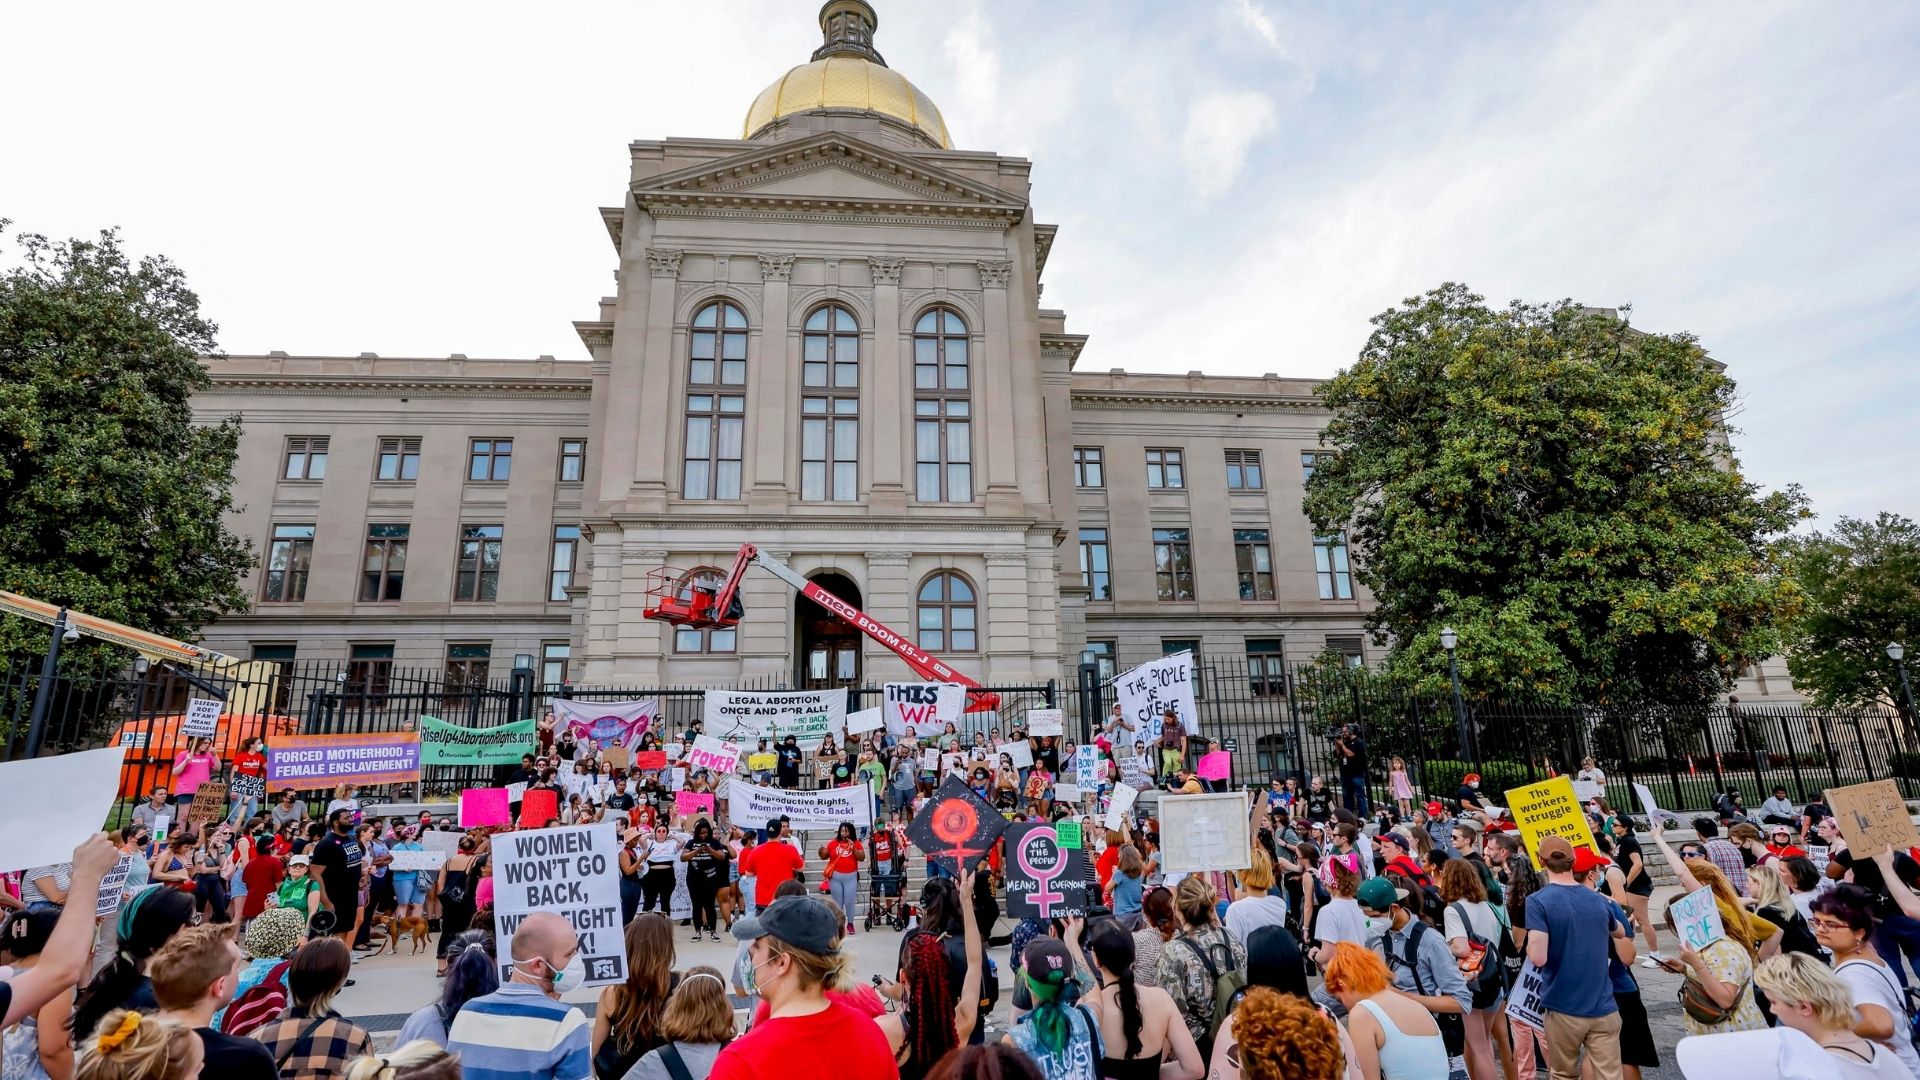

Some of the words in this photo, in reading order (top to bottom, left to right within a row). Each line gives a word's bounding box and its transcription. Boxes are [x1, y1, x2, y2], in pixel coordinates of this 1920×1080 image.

[816, 589, 856, 619] mec
[858, 617, 900, 647] BOOM
[899, 643, 929, 664] 45-J
[1126, 676, 1147, 696] THE
[728, 697, 761, 705] LEGAL
[766, 695, 821, 705] ABORTION
[886, 685, 939, 704] THIS
[720, 707, 751, 715] ONCE
[754, 707, 777, 715] AND
[806, 704, 828, 714] ALL!
[899, 703, 943, 725] WA
[809, 715, 828, 723] BACK
[806, 723, 828, 731] BACK!
[421, 726, 534, 748] RiseUp4AbortionRights.org
[274, 750, 323, 763] FORCED
[326, 747, 403, 761] MOTHERHOOD
[1081, 746, 1092, 757] MY
[690, 748, 736, 774] POWER
[1078, 758, 1095, 769] BODY
[275, 763, 325, 778] FEMALE
[328, 758, 413, 775] ENSLAVEMENT!
[1081, 768, 1092, 778] MY
[231, 778, 265, 791] FORCED
[241, 773, 264, 785] STOP
[1076, 780, 1097, 790] CHOICE
[198, 783, 208, 791] MY
[210, 784, 226, 793] BODY
[231, 785, 264, 798] BIRTHS
[1528, 788, 1551, 800] The
[754, 793, 815, 806] Reproductive
[817, 798, 850, 807] Rights,
[1520, 795, 1568, 814] workers
[749, 802, 783, 812] Women
[785, 805, 811, 814] Won't
[813, 807, 826, 815] Go
[828, 807, 854, 815] Back!
[1524, 805, 1572, 825] struggle
[1536, 827, 1558, 839] has
[1560, 823, 1575, 833] no
[515, 831, 592, 858] WOMEN
[1030, 840, 1047, 849] WE
[1029, 848, 1049, 857] THE
[1029, 857, 1057, 866] PEOPLE
[504, 857, 570, 885] WON'T
[576, 854, 606, 877] GO
[1006, 880, 1037, 893] MEANS
[1050, 880, 1087, 892] EVERYONE
[526, 881, 589, 908] BACK,
[1686, 914, 1719, 947] ROE
[593, 964, 618, 979] PSL
[1037, 1041, 1093, 1080] TRUST
